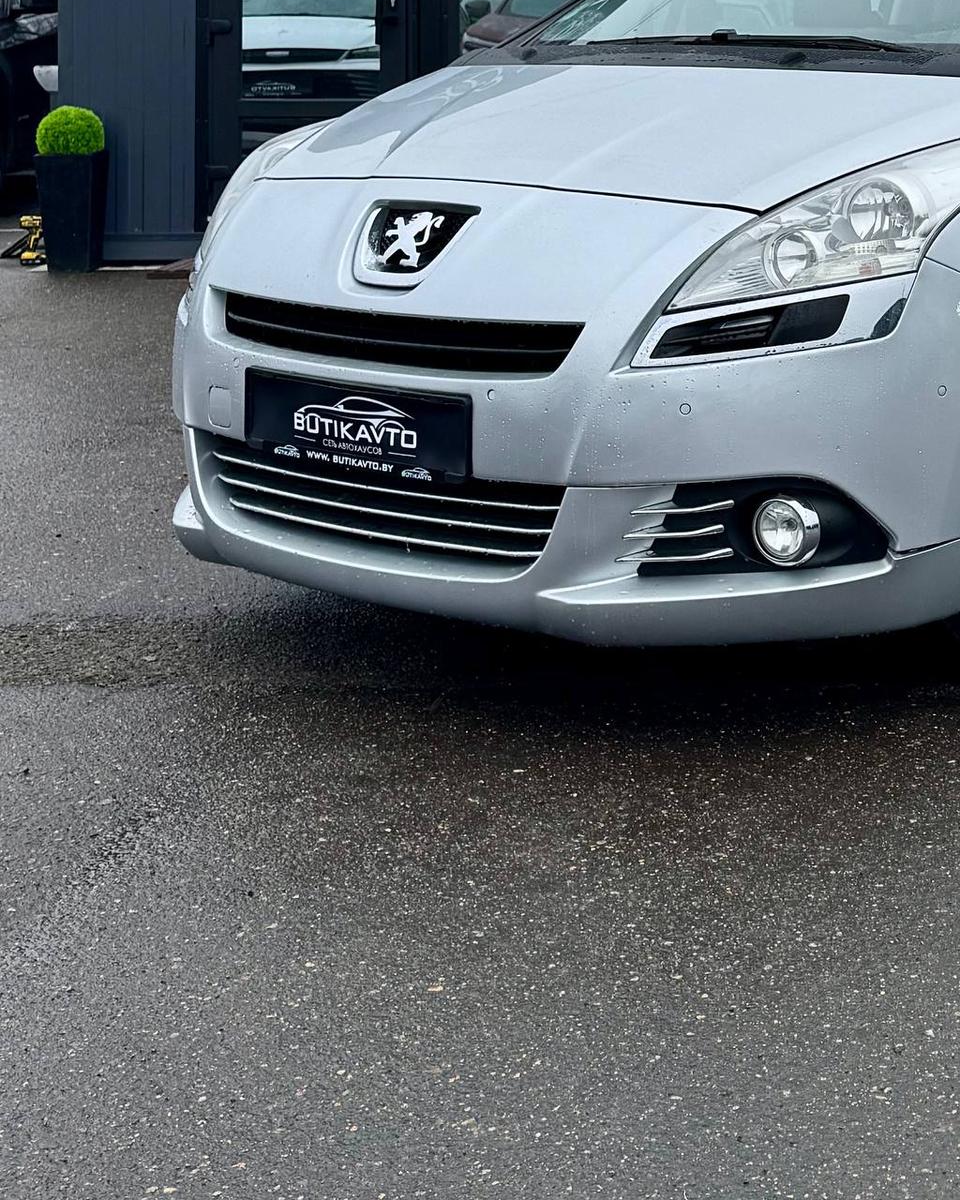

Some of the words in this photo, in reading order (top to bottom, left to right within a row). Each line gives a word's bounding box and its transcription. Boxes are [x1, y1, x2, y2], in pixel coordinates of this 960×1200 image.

[294, 412, 417, 449] BUTIKAVTO
[306, 450, 330, 462] WWW.
[333, 455, 394, 473] BUTIKAVTO.BY
